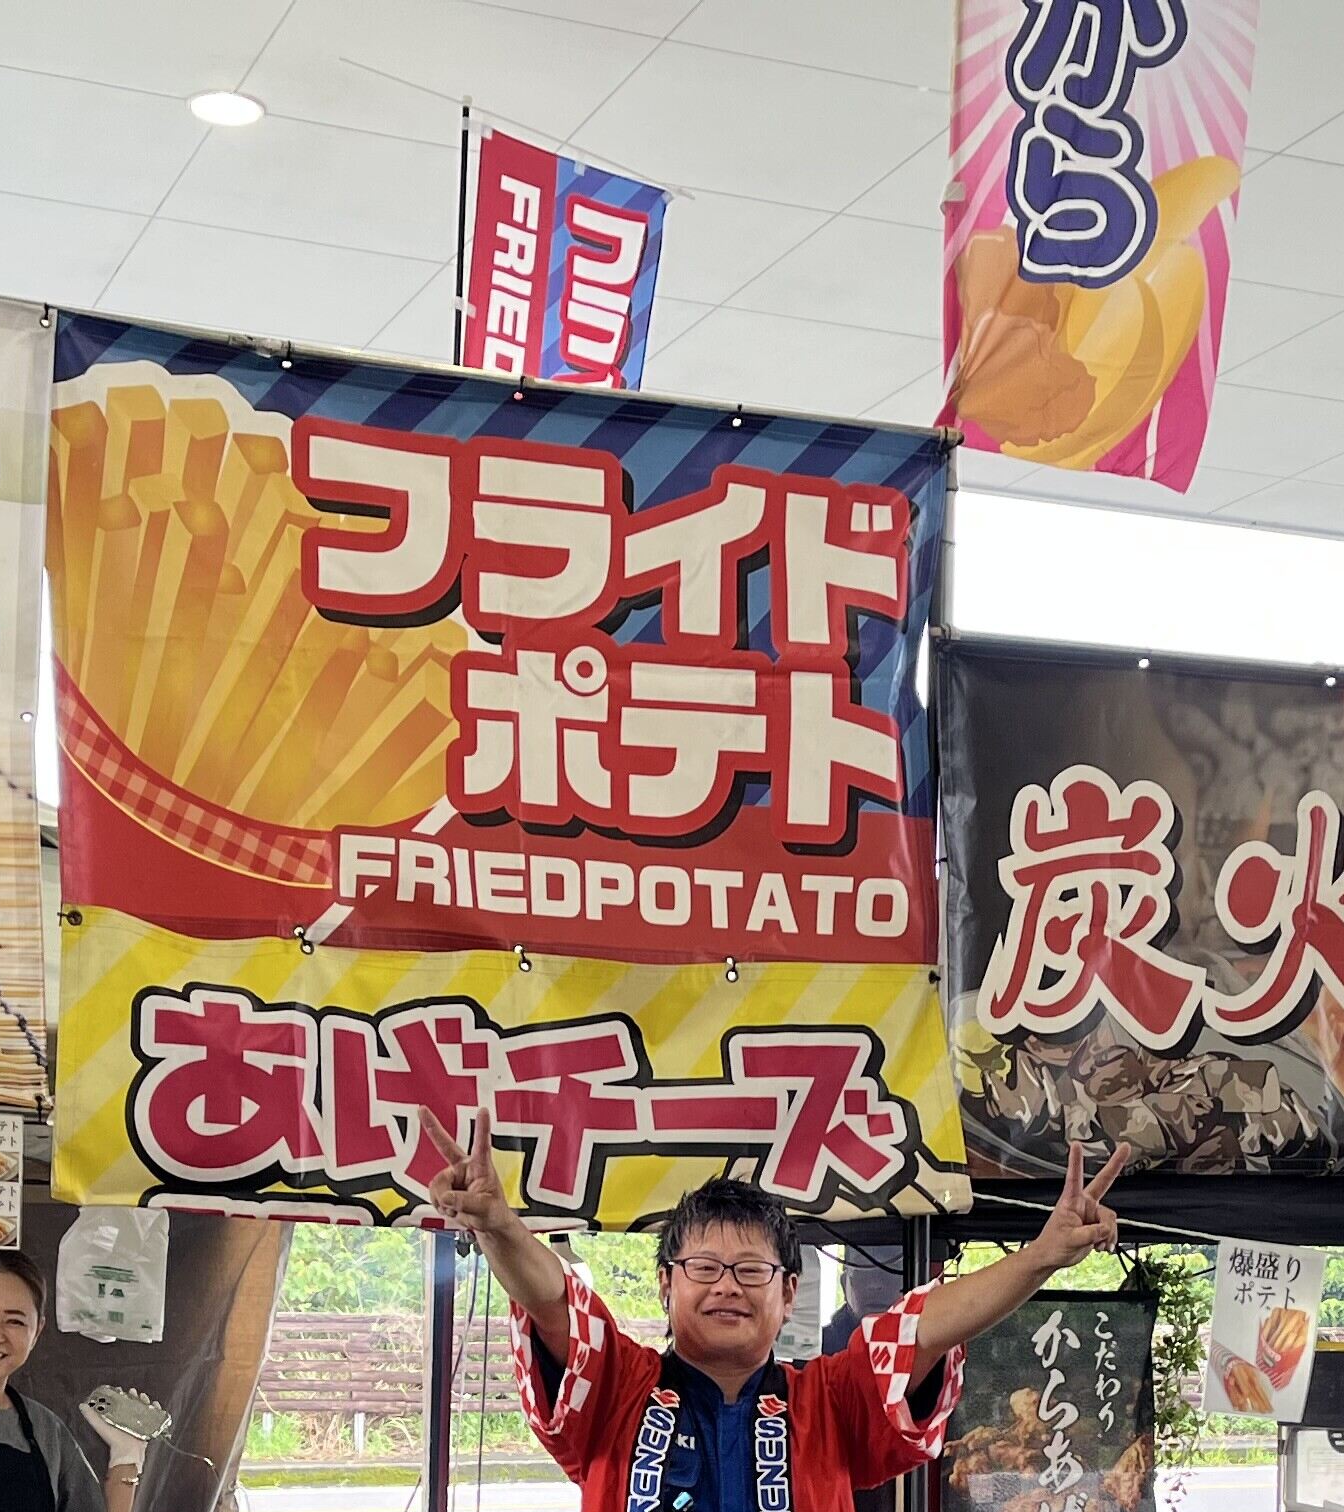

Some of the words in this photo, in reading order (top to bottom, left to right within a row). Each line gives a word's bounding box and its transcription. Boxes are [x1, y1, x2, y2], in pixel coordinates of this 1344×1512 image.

[296, 420, 911, 655] フライド
[451, 638, 906, 838] ポテト
[338, 831, 910, 940] FRIEDPOTATO
[134, 992, 908, 1202] あげチーズ
[1229, 1247, 1302, 1282] 爆盛り
[1234, 1280, 1297, 1311] ポテト
